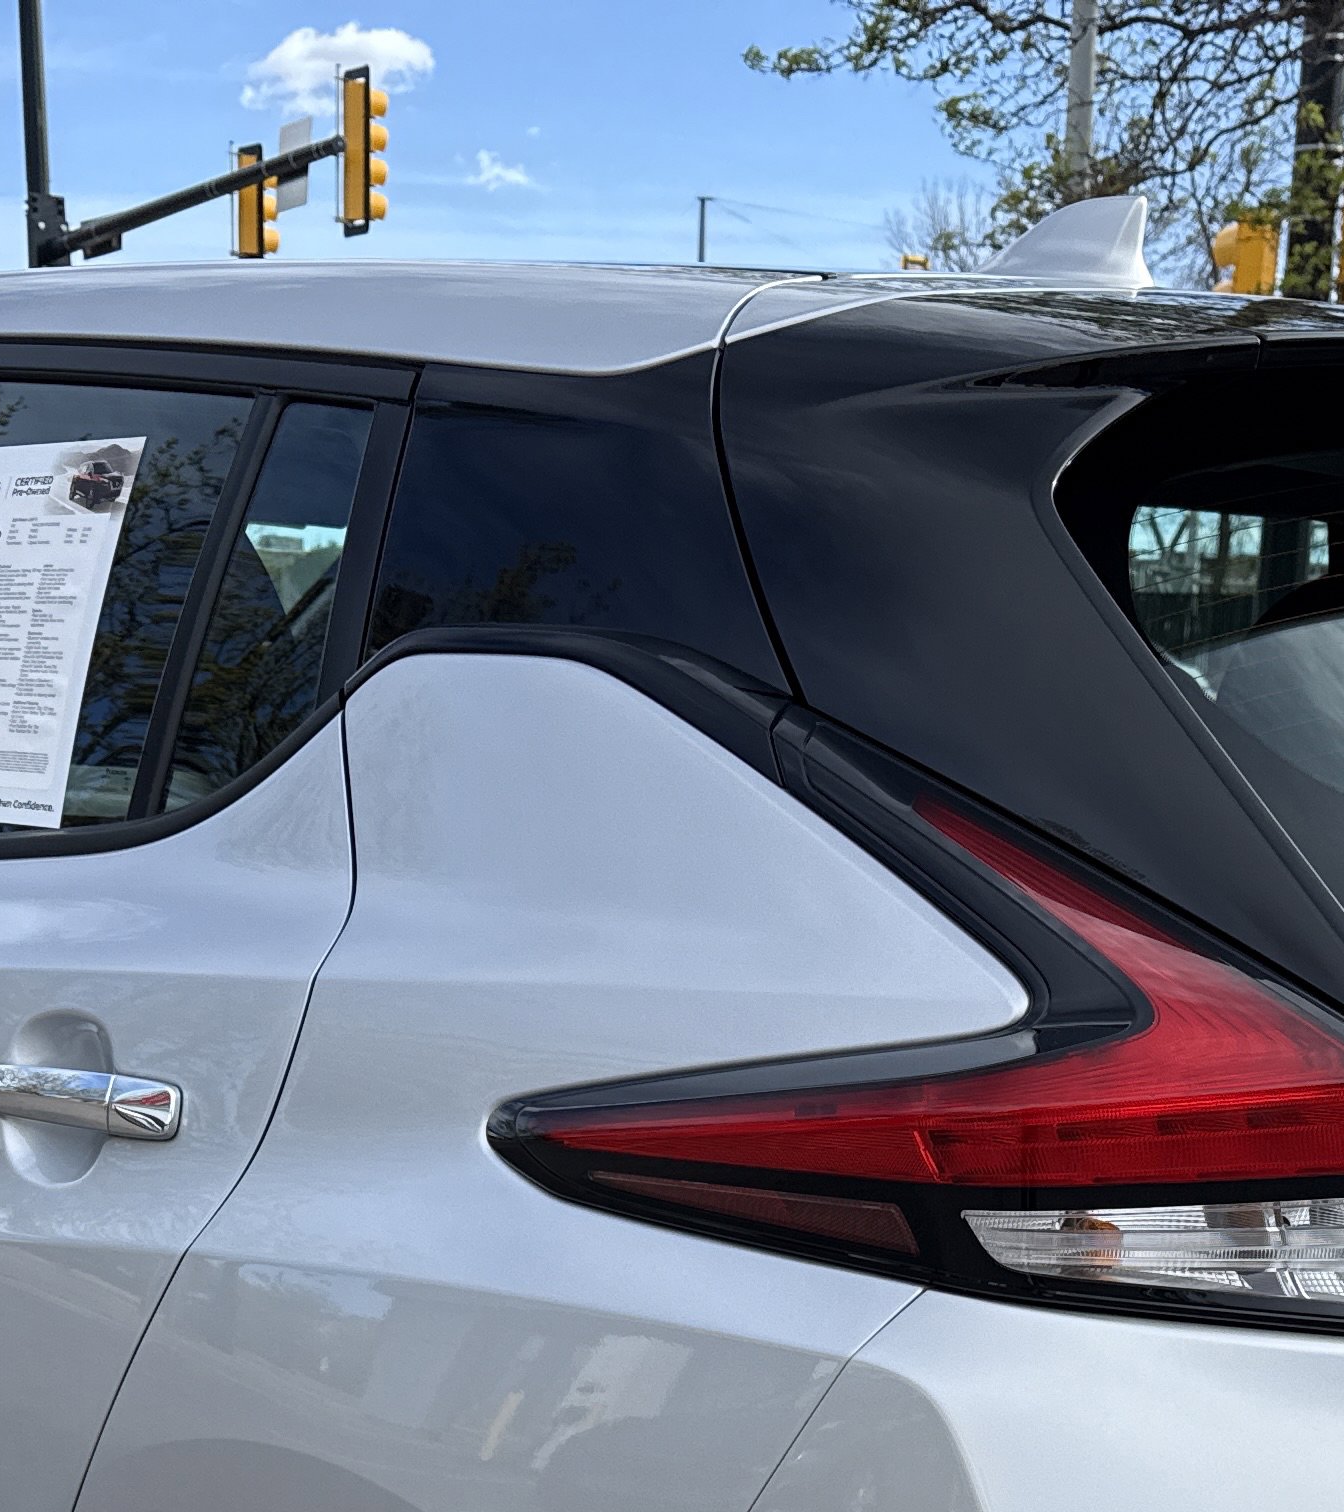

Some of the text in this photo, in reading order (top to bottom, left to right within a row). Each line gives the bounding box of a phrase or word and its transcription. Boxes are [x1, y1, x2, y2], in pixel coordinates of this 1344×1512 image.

[14, 475, 54, 487] CERTIFIED
[11, 486, 51, 497] Pre-Owned
[12, 799, 55, 812] Confidence.
